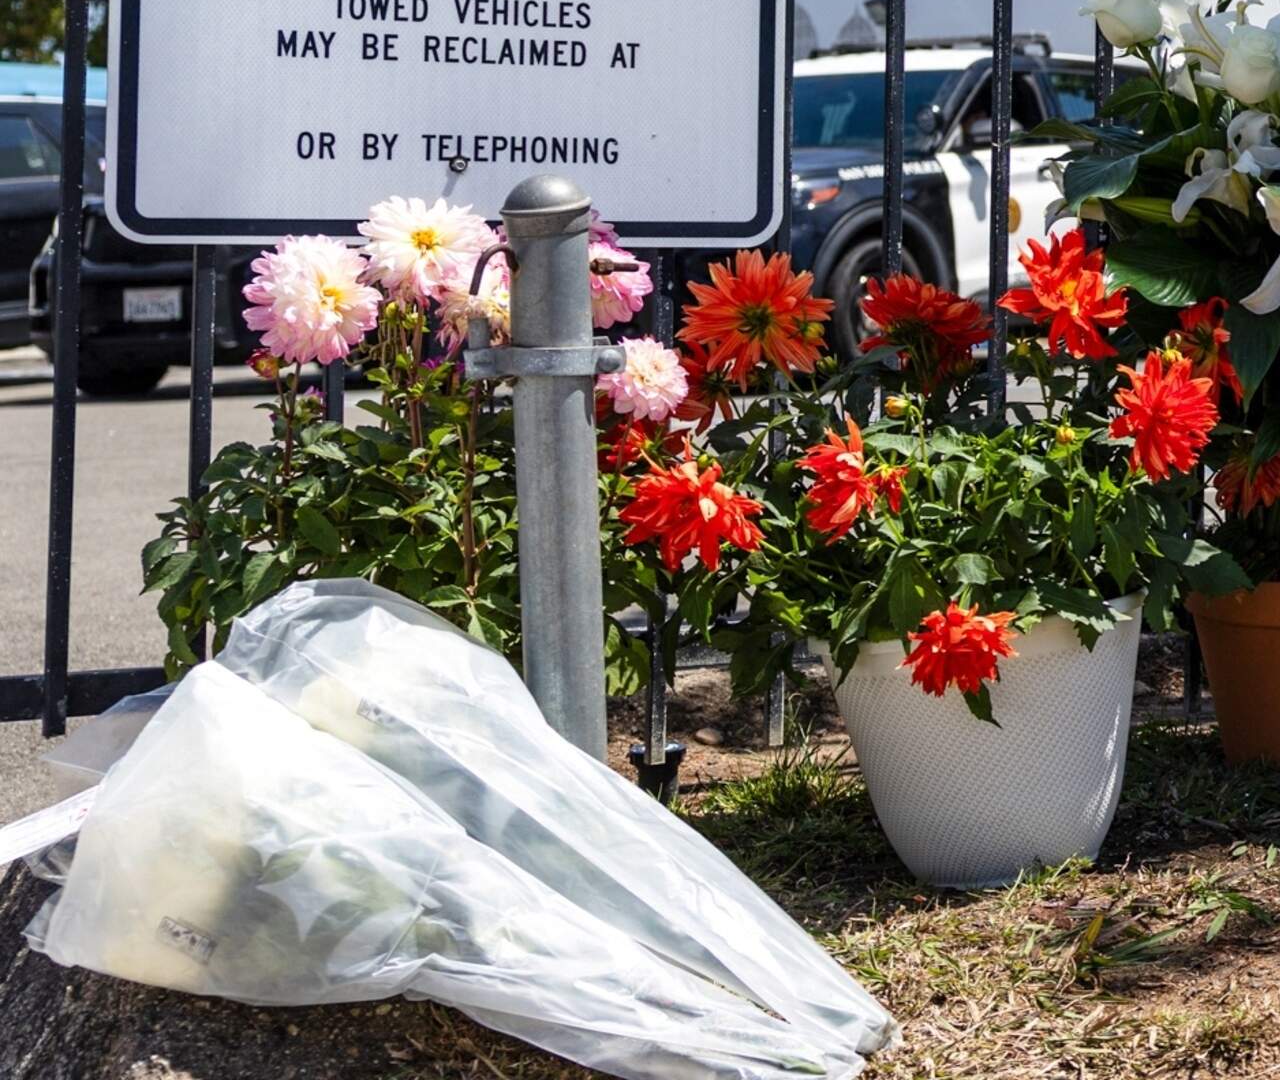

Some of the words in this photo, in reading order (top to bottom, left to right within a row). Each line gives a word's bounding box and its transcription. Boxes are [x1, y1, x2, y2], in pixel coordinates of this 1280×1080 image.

[278, 30, 336, 58] MAY
[363, 33, 398, 60] BE
[424, 36, 586, 66] RECLAIMED
[611, 43, 640, 68] AT
[297, 132, 335, 159] OR
[363, 134, 398, 160] BY
[422, 135, 618, 165] TELEPHONING
